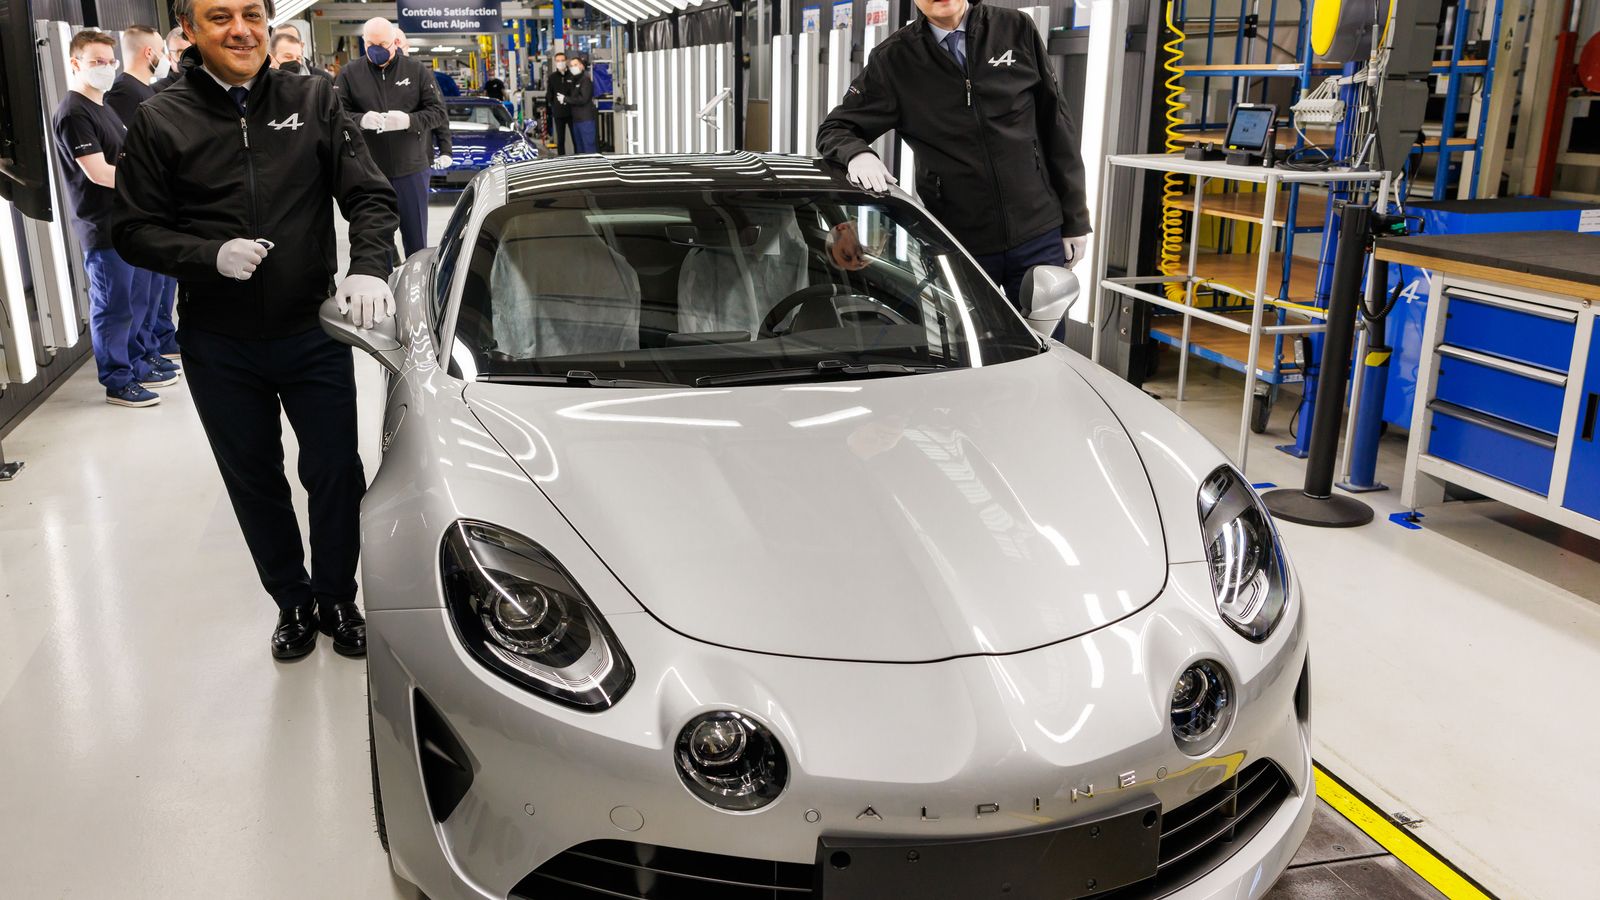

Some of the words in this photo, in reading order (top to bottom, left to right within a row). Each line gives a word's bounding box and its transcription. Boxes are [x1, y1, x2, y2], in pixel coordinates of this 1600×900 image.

[402, 7, 442, 16] Contrôle
[443, 7, 498, 16] Satisfaction
[421, 20, 449, 29] Client
[450, 20, 480, 29] Alpine
[855, 769, 1137, 821] ALPINE
